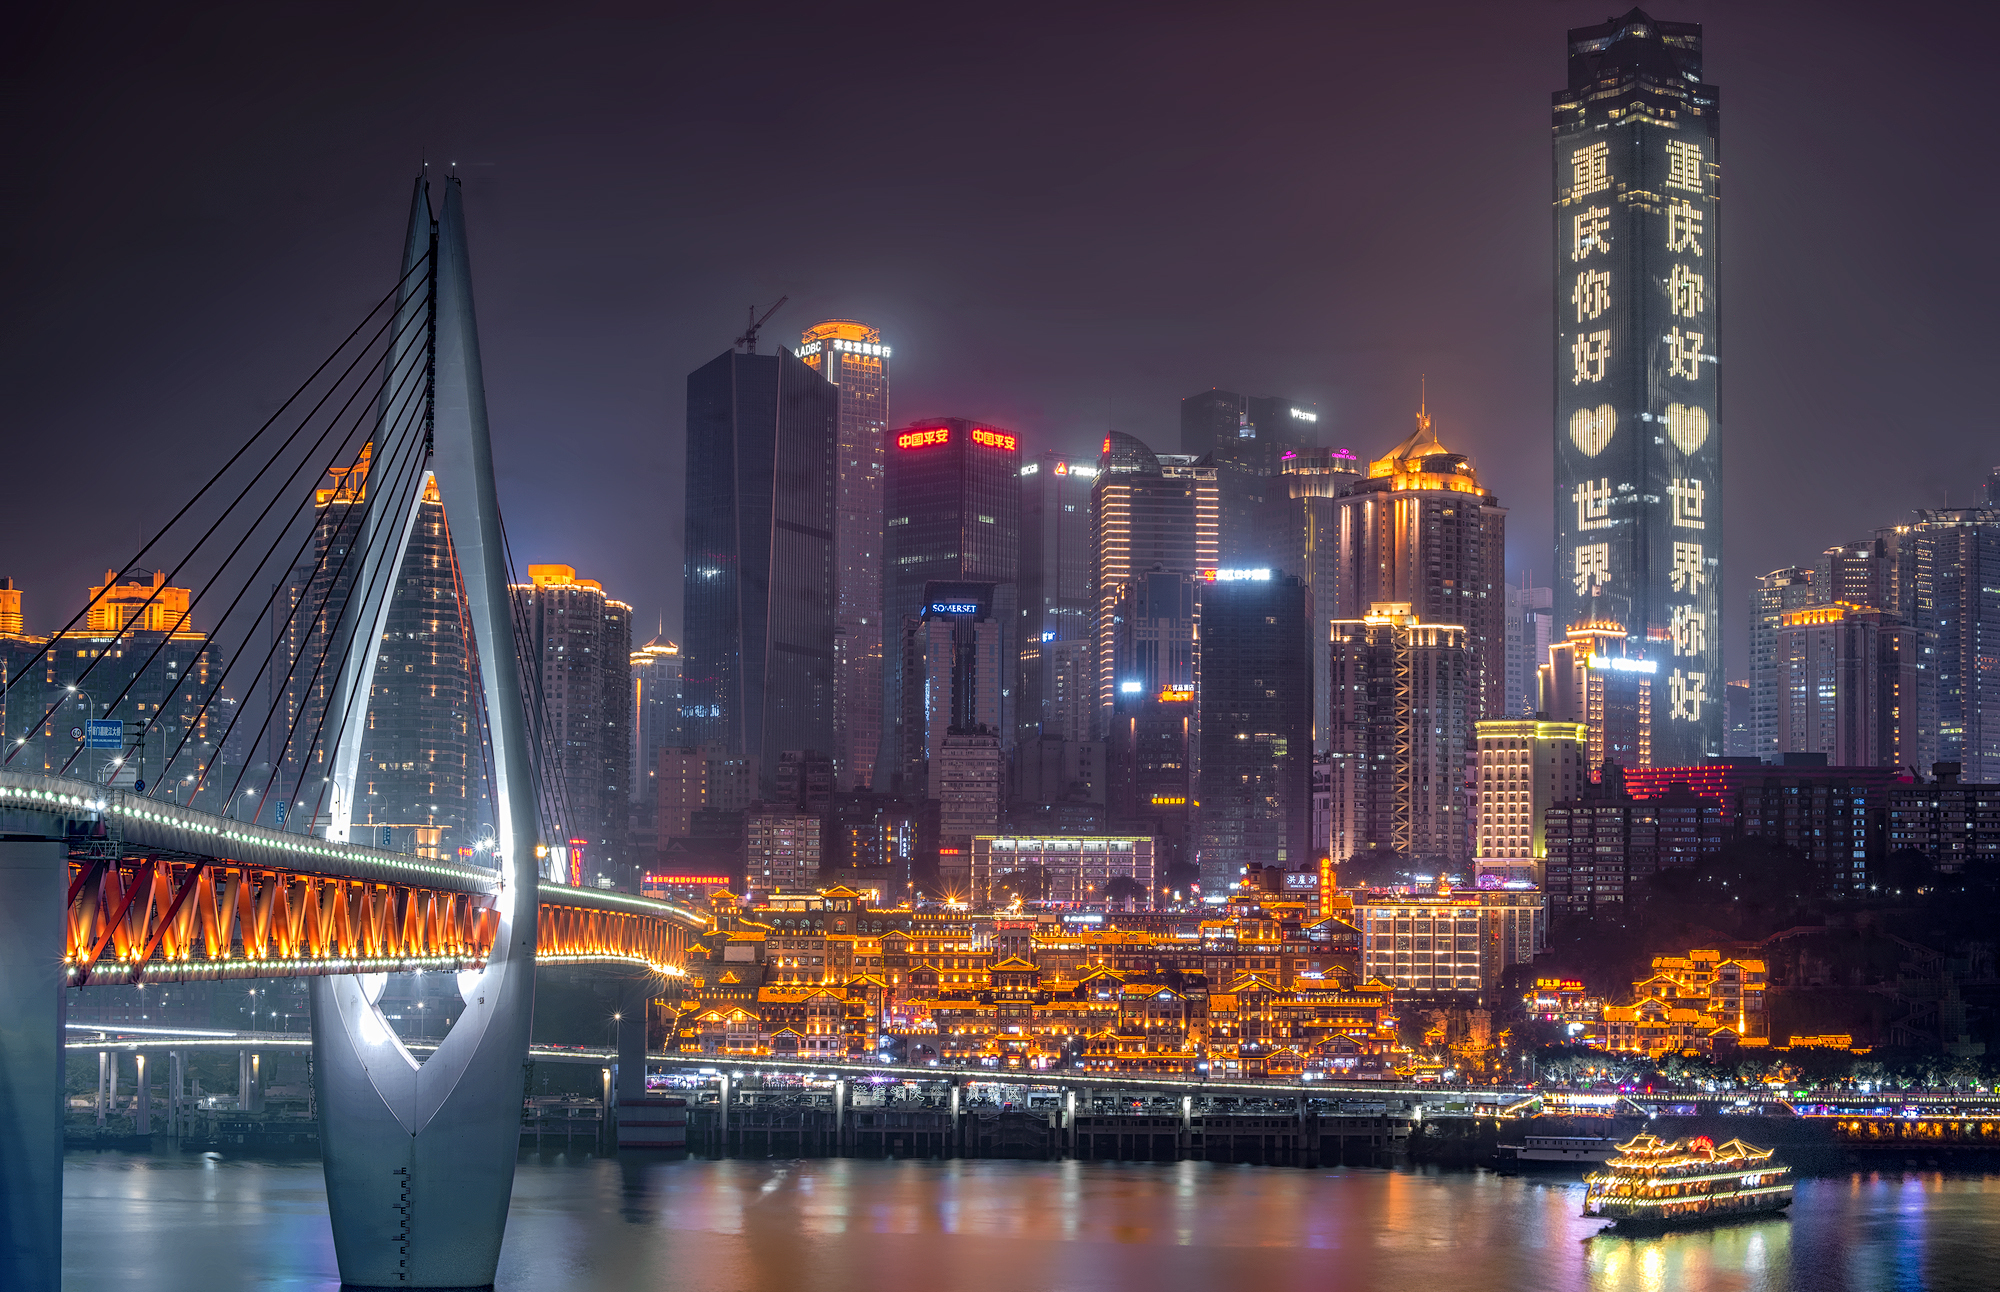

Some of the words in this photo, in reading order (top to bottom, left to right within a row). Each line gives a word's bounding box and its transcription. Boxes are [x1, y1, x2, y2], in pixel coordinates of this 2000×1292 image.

[1571, 141, 1611, 386] 重庆你好
[1666, 139, 1704, 382] 重庆你好
[898, 429, 948, 449] 中国平安
[972, 429, 1015, 450] 中国平安
[932, 604, 977, 613] SOMERSET
[1669, 477, 1706, 722] 世界你好
[72, 729, 81, 737] 60
[1286, 874, 1318, 885] 洪崖洞
